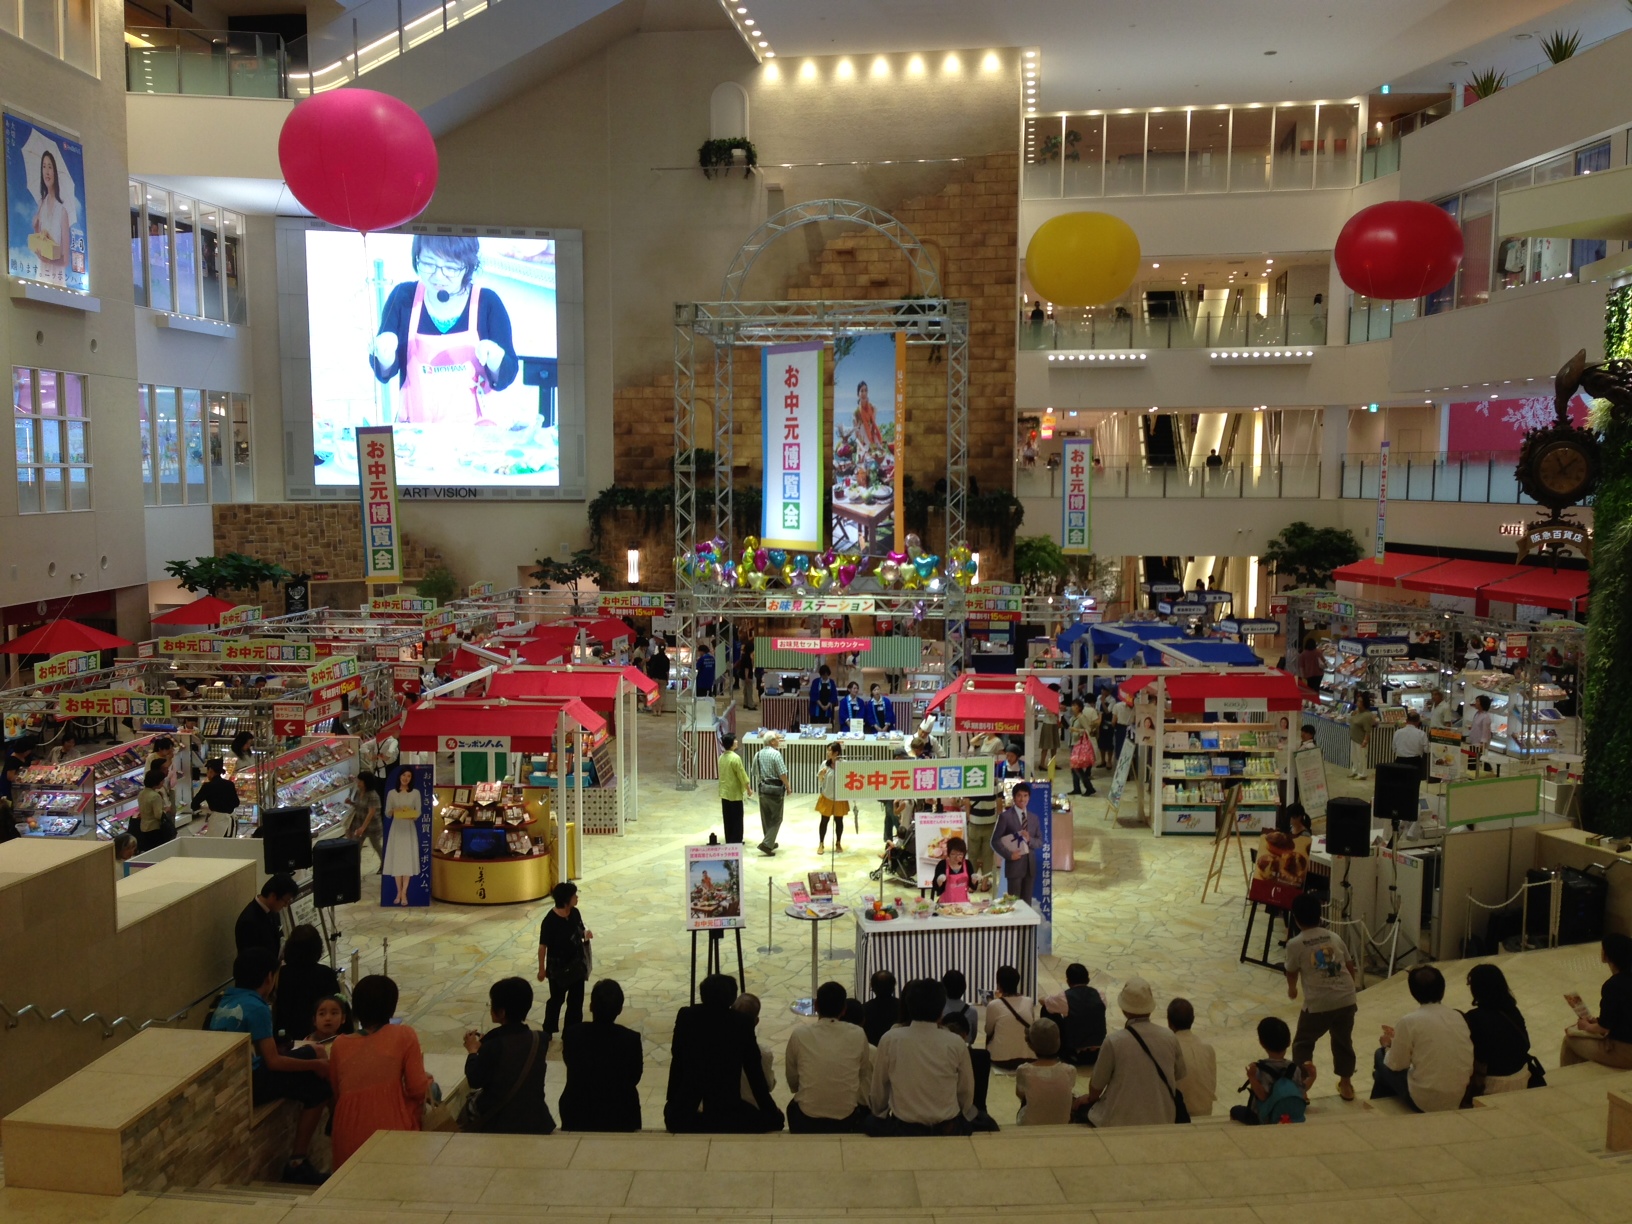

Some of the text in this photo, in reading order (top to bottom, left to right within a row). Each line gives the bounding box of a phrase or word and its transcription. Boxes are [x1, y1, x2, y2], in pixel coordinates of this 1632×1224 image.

[784, 365, 800, 528] お中元博覧会
[403, 488, 477, 498] ART VISION
[1070, 449, 1085, 545] お中元博覧会
[367, 441, 393, 569] お中元博覧会
[1530, 529, 1584, 543] 阪急百貨店
[372, 600, 433, 610] お中元博覧会
[602, 596, 661, 606] お中元博覧会
[767, 600, 874, 611] お味見ステーション
[965, 600, 1018, 610] 中元博覧会
[222, 608, 260, 625] お中元博覧会
[226, 646, 310, 660] お中元博覧会
[39, 655, 97, 680] お中元博覧会
[311, 658, 356, 685] お中元博覧会
[65, 698, 165, 715] お中元博覧会
[458, 740, 503, 748] ニッポンハム
[844, 767, 986, 791] お中元博覧会
[420, 772, 432, 892] おいしさ、品質、ニッポンハム。
